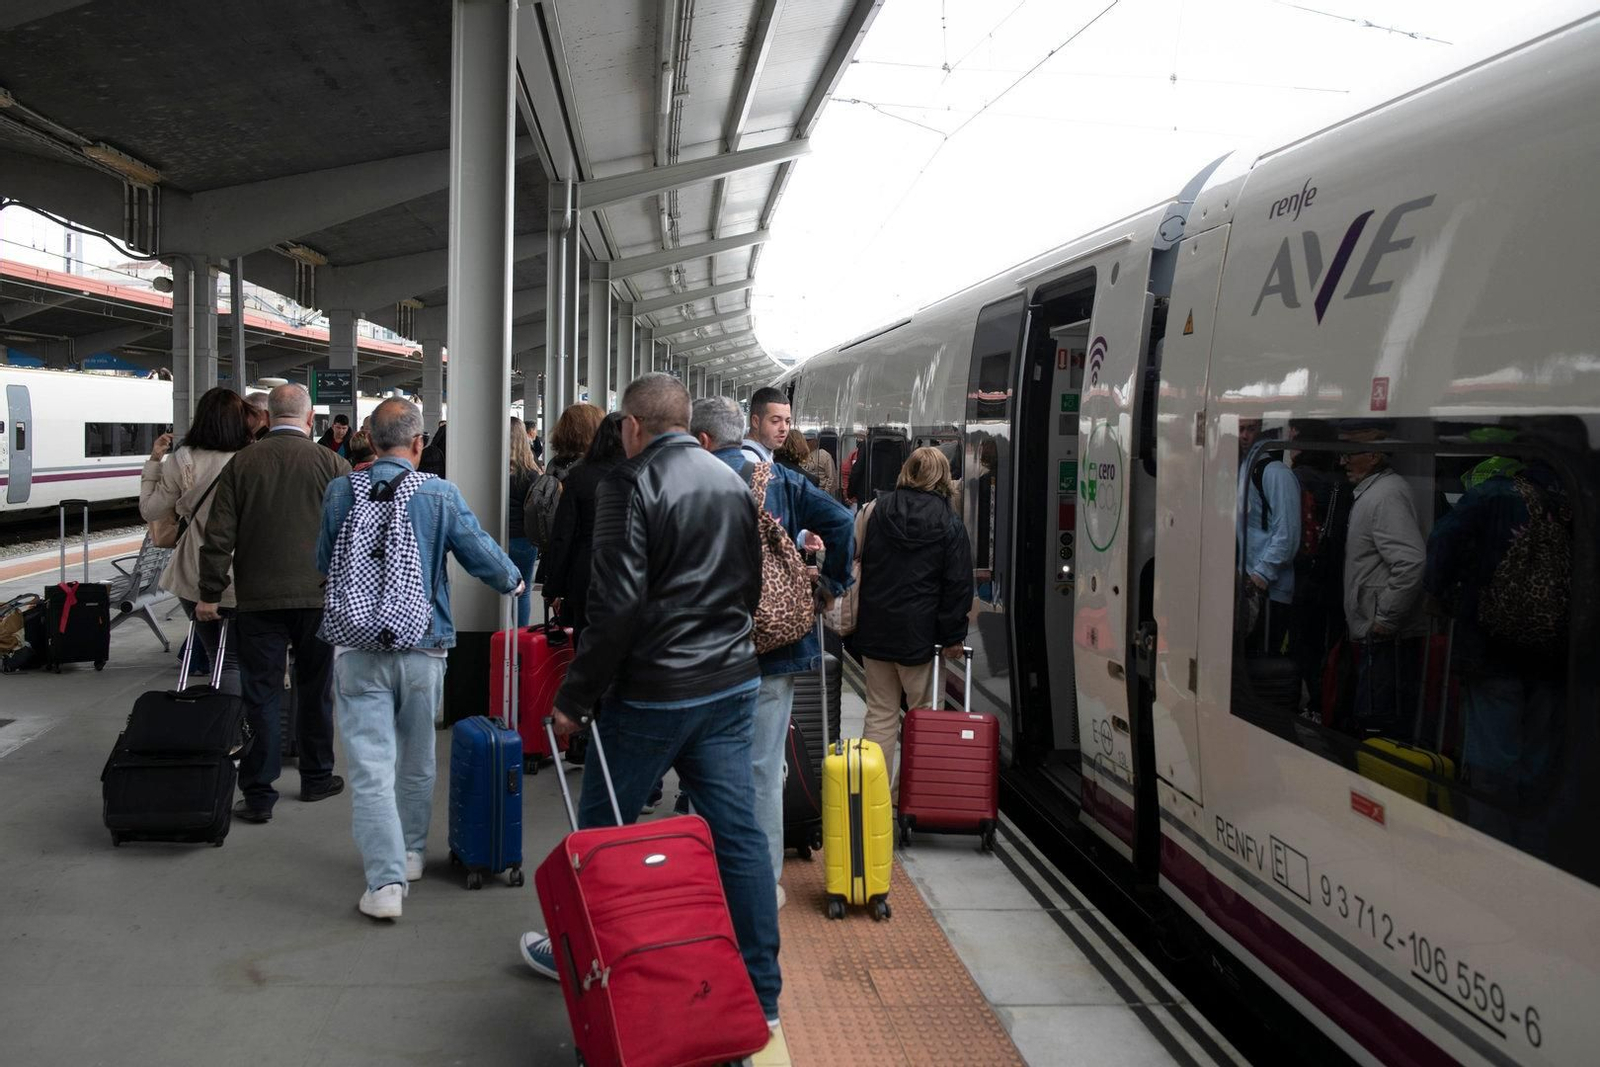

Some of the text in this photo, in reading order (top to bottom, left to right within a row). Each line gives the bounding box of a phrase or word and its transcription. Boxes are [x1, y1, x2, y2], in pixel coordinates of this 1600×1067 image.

[1269, 177, 1317, 221] renfe
[1251, 193, 1437, 326] AVE
[1098, 463, 1116, 481] cero
[1216, 814, 1264, 871] RENFV
[1274, 844, 1284, 880] E
